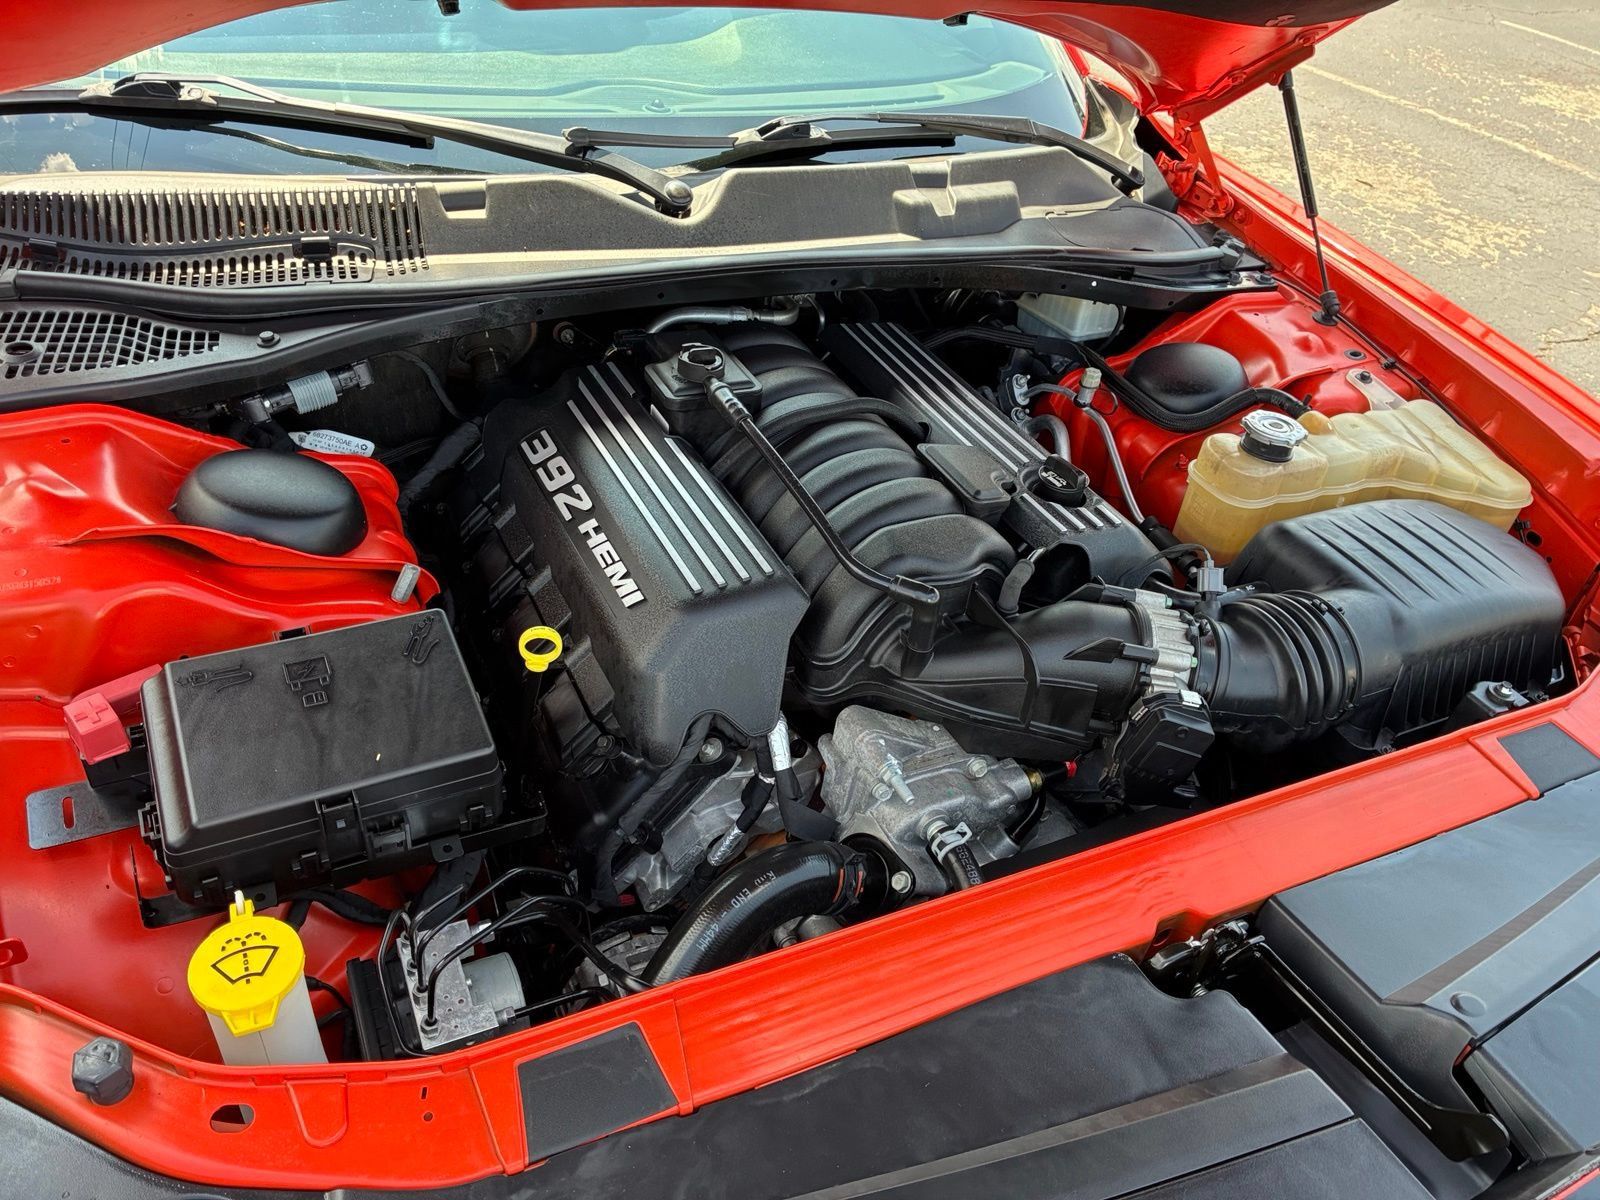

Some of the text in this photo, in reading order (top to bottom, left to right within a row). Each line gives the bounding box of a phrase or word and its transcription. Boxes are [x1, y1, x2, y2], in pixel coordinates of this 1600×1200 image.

[520, 429, 645, 608] 392 HEMI
[731, 888, 752, 908] END
[696, 923, 719, 951] 44MM
